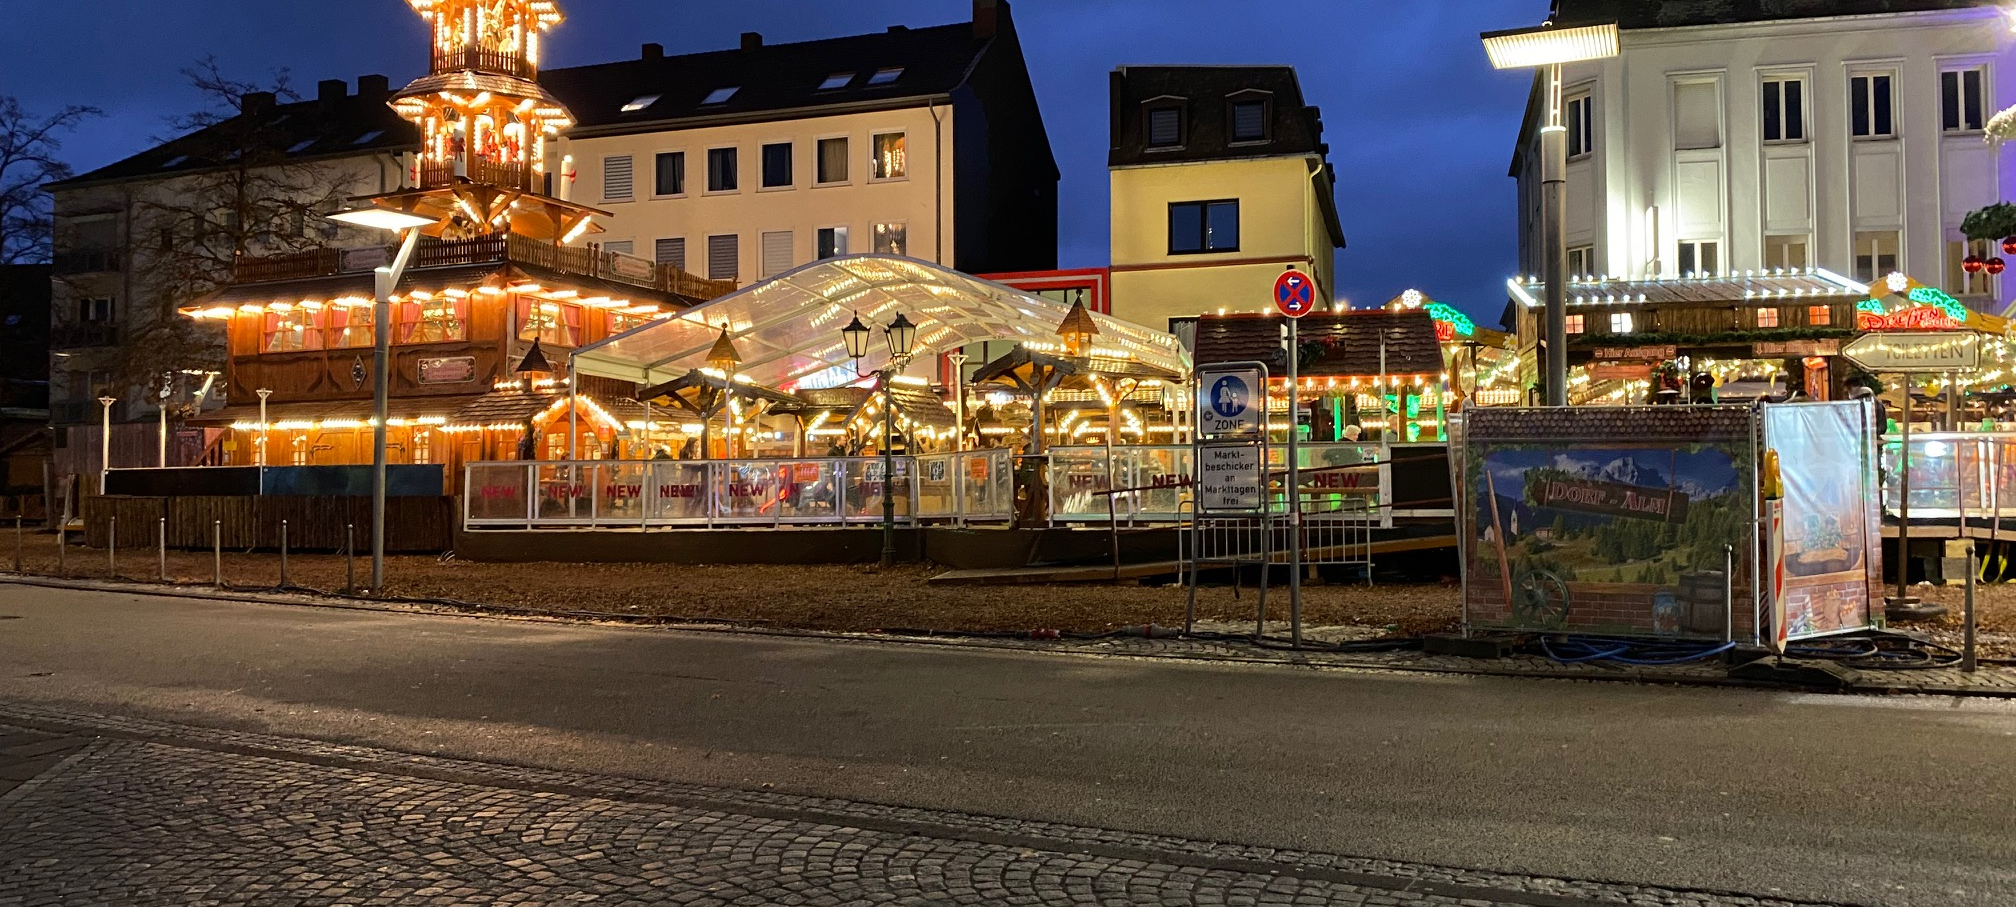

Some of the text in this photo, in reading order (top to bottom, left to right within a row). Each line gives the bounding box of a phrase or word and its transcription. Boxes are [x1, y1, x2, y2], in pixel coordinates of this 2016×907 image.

[1885, 342, 1964, 360] TOILETTEN
[1215, 420, 1245, 430] ZONE
[1205, 462, 1254, 472] beschicker
[1314, 472, 1361, 488] NEW
[548, 484, 583, 498] NEW
[606, 485, 642, 498] NEW
[729, 484, 764, 497] NEW
[1205, 485, 1256, 496] Markttagen
[1223, 496, 1239, 505] frei
[1550, 482, 1606, 506] DORF
[1620, 491, 1667, 515] ALM
